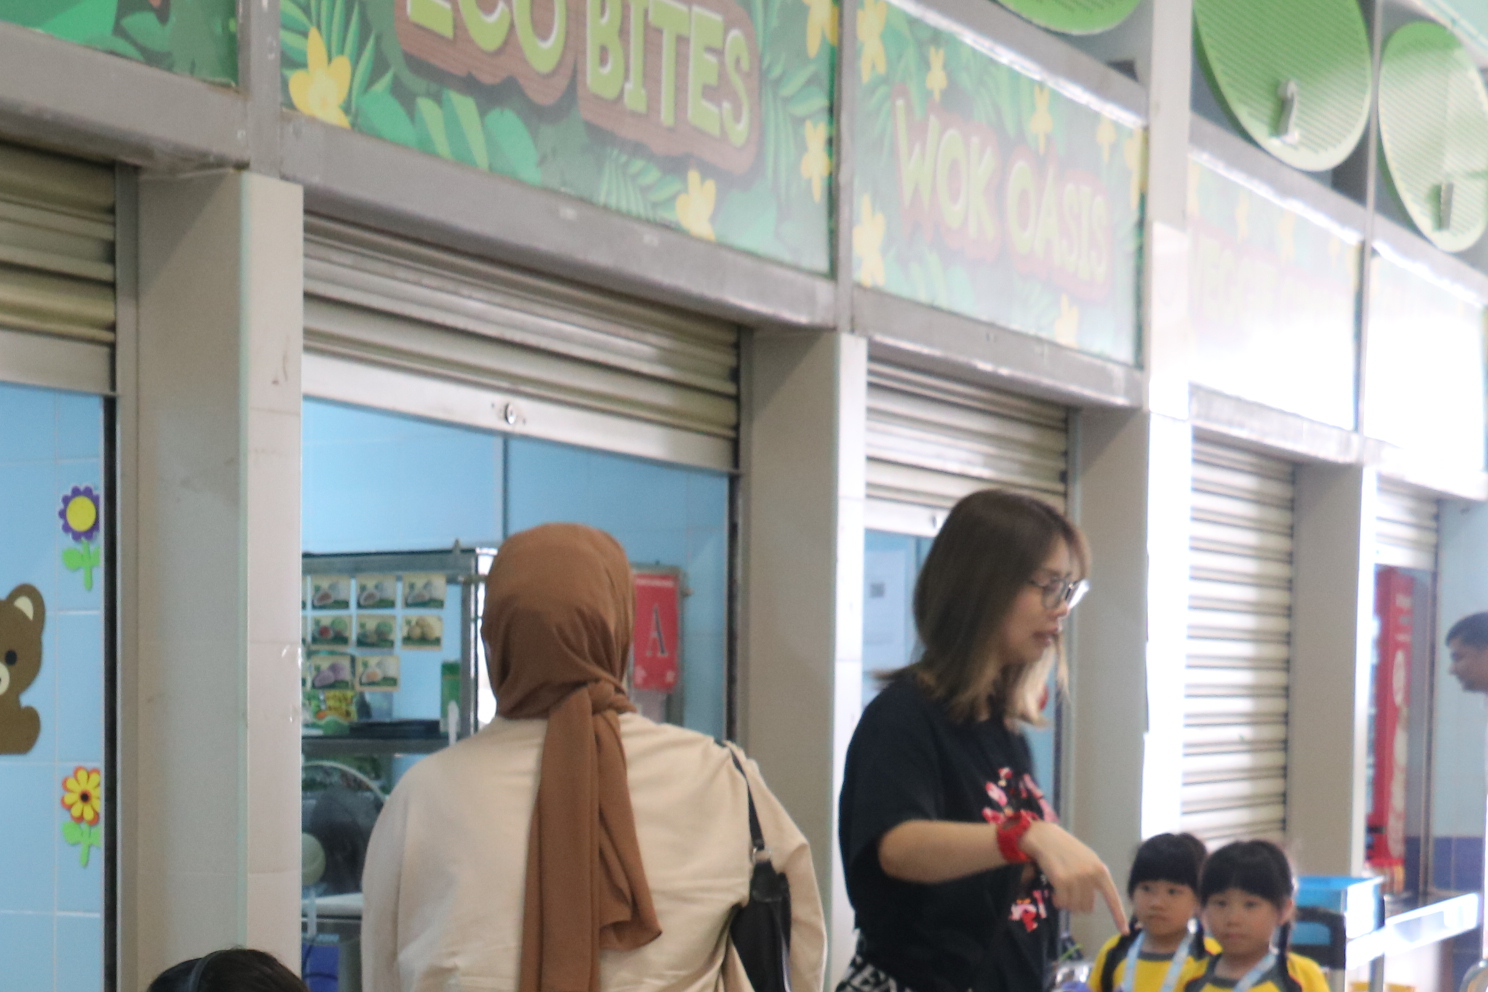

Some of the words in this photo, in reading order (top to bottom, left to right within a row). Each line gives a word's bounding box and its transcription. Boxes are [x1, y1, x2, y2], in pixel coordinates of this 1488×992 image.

[586, 0, 751, 147] BITES
[895, 98, 996, 242] WOK
[1006, 160, 1108, 283] OASIS
[645, 602, 669, 658] A
